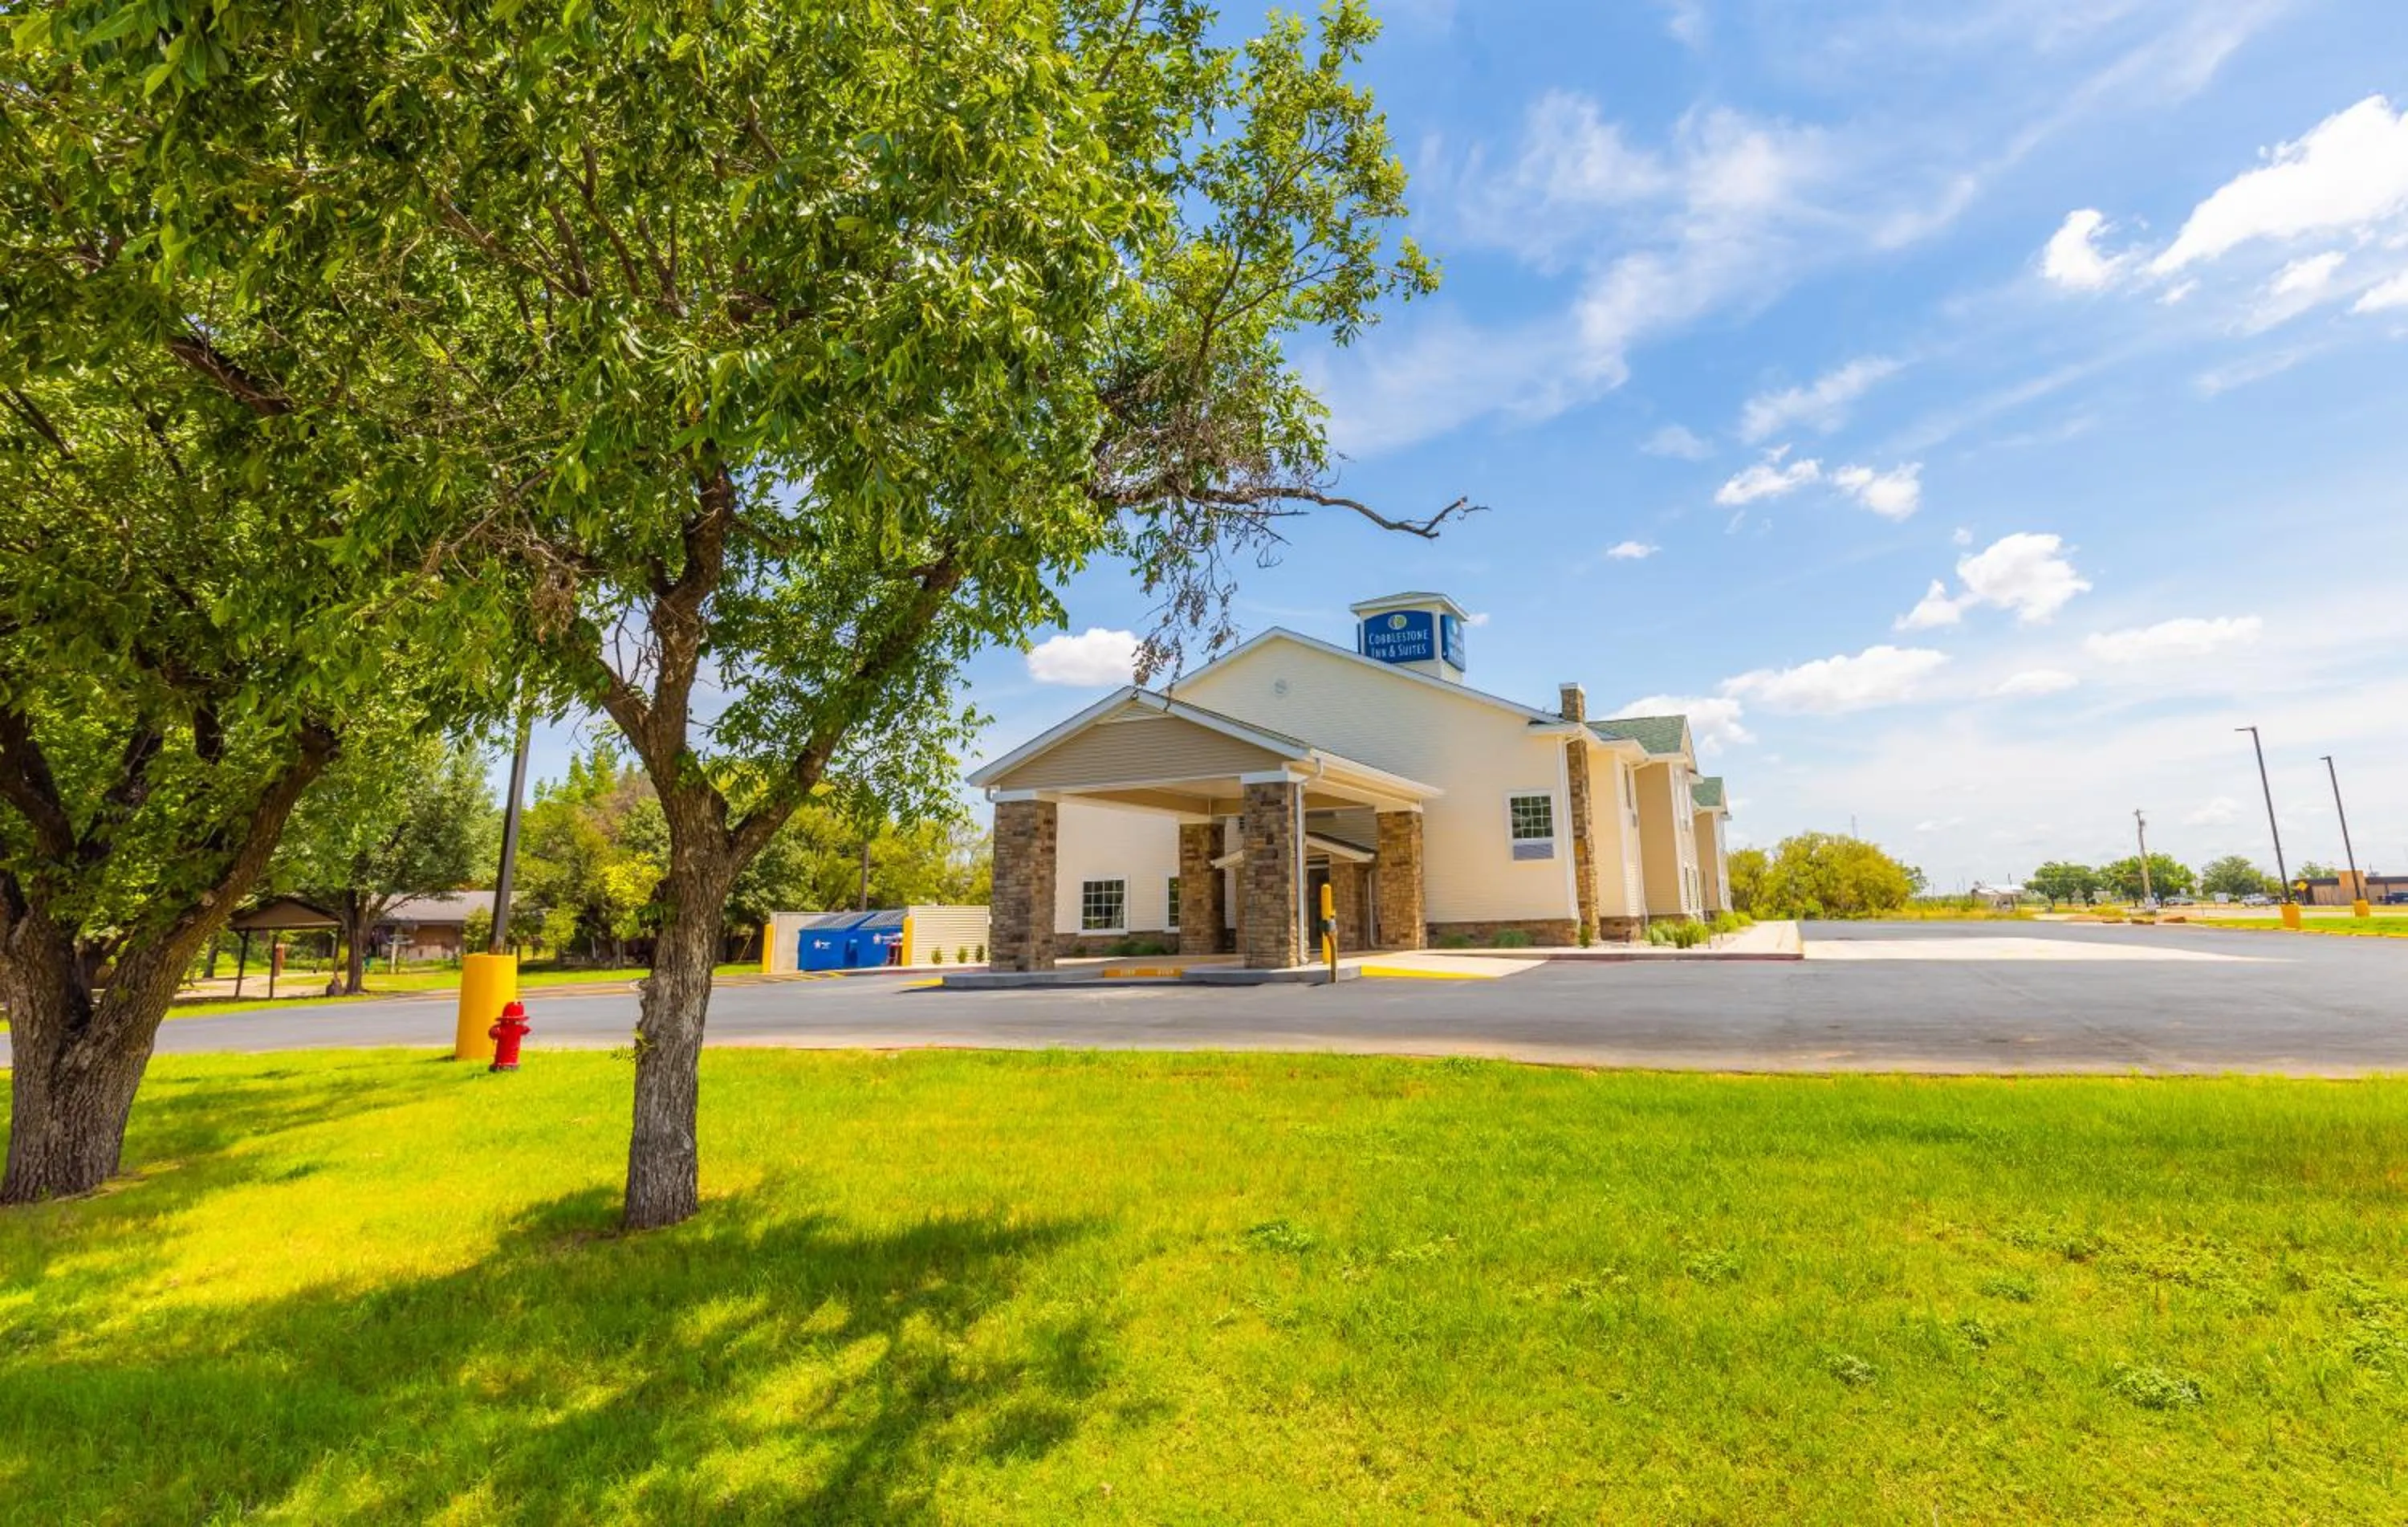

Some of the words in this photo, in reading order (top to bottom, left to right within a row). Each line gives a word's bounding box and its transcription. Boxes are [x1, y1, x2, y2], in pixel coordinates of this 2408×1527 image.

[1369, 629, 1430, 645] COBBLESTONE
[1371, 646, 1387, 658] INN
[1389, 645, 1396, 658] &
[1397, 643, 1426, 656] SUITES
